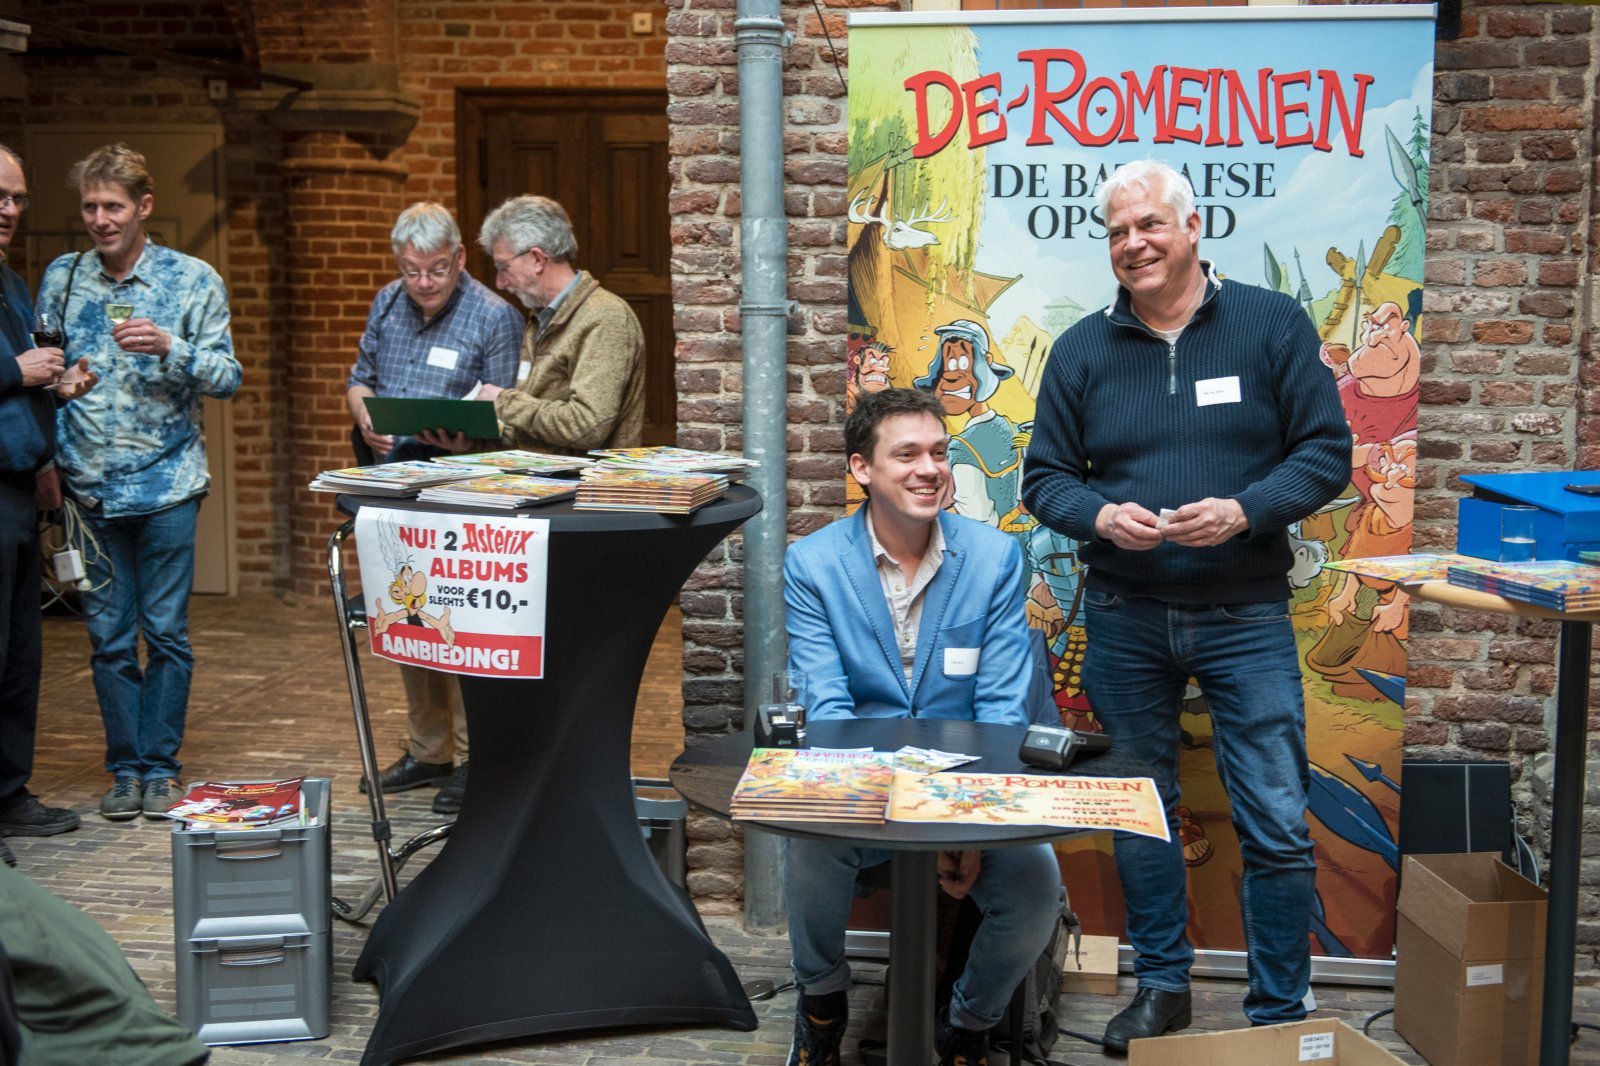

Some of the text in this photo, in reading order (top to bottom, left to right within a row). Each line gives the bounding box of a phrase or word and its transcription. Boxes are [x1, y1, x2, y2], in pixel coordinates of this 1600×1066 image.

[1007, 48, 1375, 158] ROMEINEN
[991, 162, 1276, 199] DE BAAFSE
[1028, 204, 1236, 239] OPSD
[399, 526, 436, 550] NU!
[444, 530, 458, 551] 2
[429, 557, 528, 583] ALBUMS
[429, 596, 465, 608] SLECHTS
[437, 585, 465, 596] VOOR
[382, 633, 520, 671] AANBIEDING!
